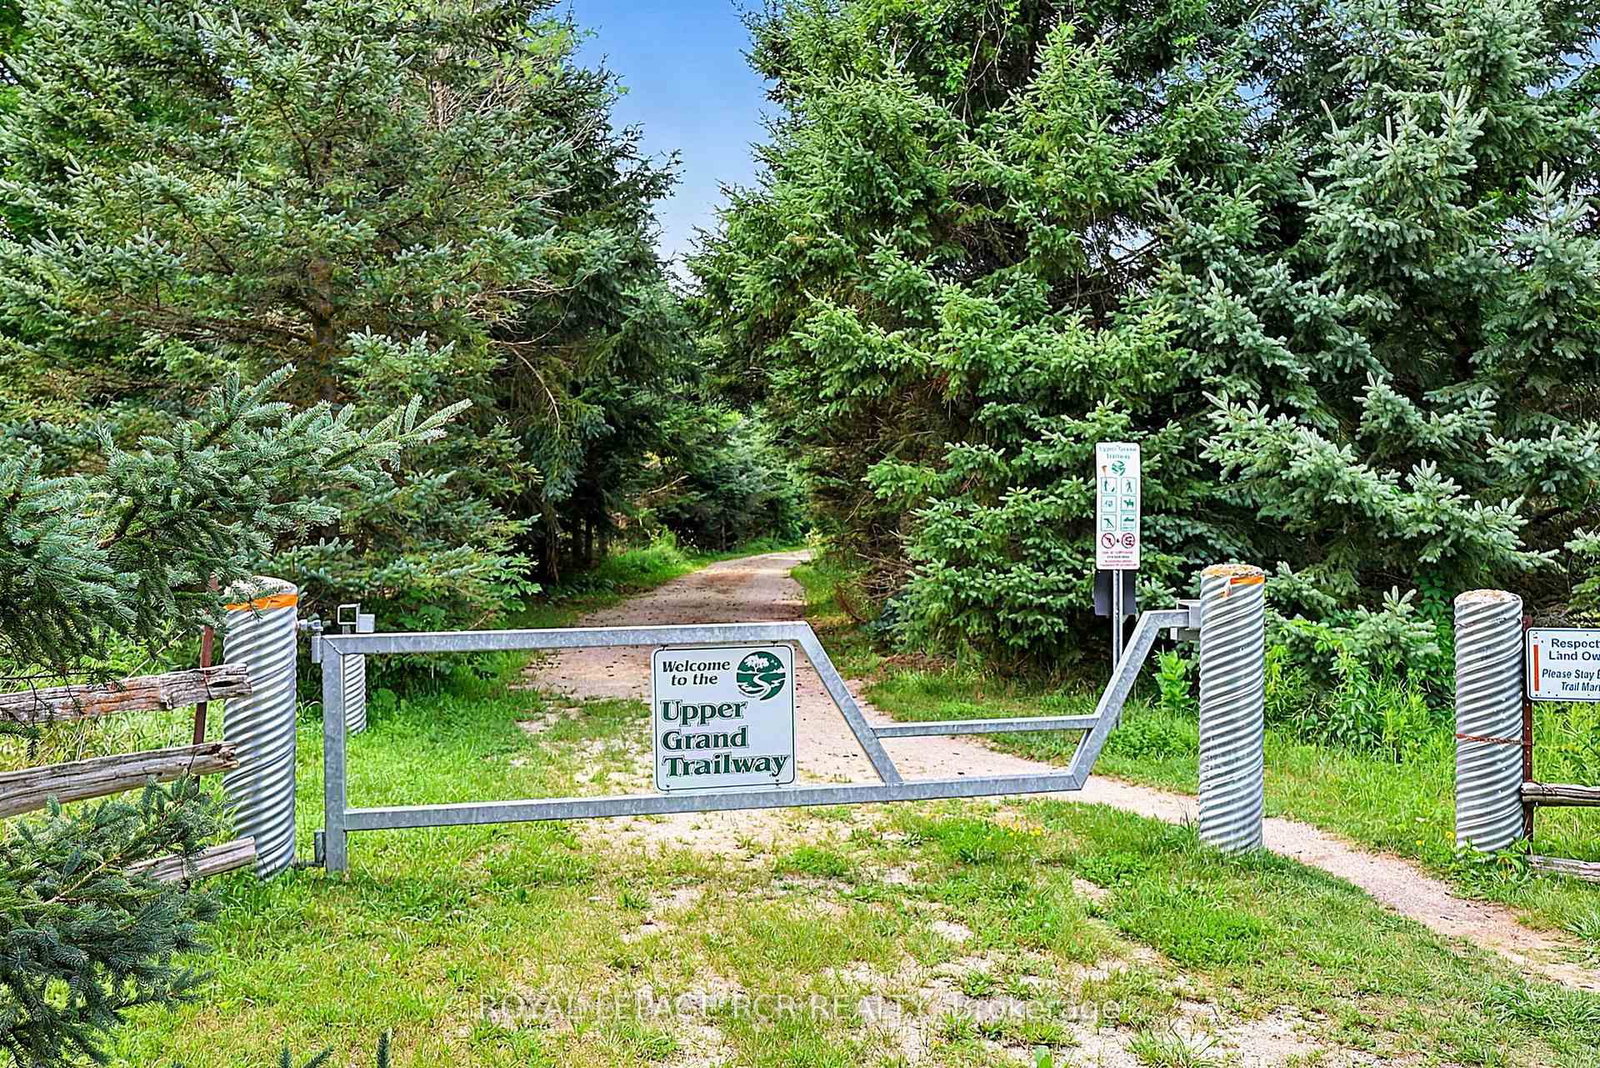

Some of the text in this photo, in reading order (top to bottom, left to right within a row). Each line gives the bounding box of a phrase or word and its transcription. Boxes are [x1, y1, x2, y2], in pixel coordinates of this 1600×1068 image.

[1548, 650, 1578, 661] Land
[662, 660, 731, 673] Welcome
[671, 673, 718, 686] to the
[1542, 668, 1572, 679] Please
[1574, 669, 1595, 681] Stay
[1561, 682, 1600, 692] Trail Mar
[660, 699, 748, 727] Upper
[661, 725, 749, 751] Grand
[662, 751, 791, 778] Trailway
